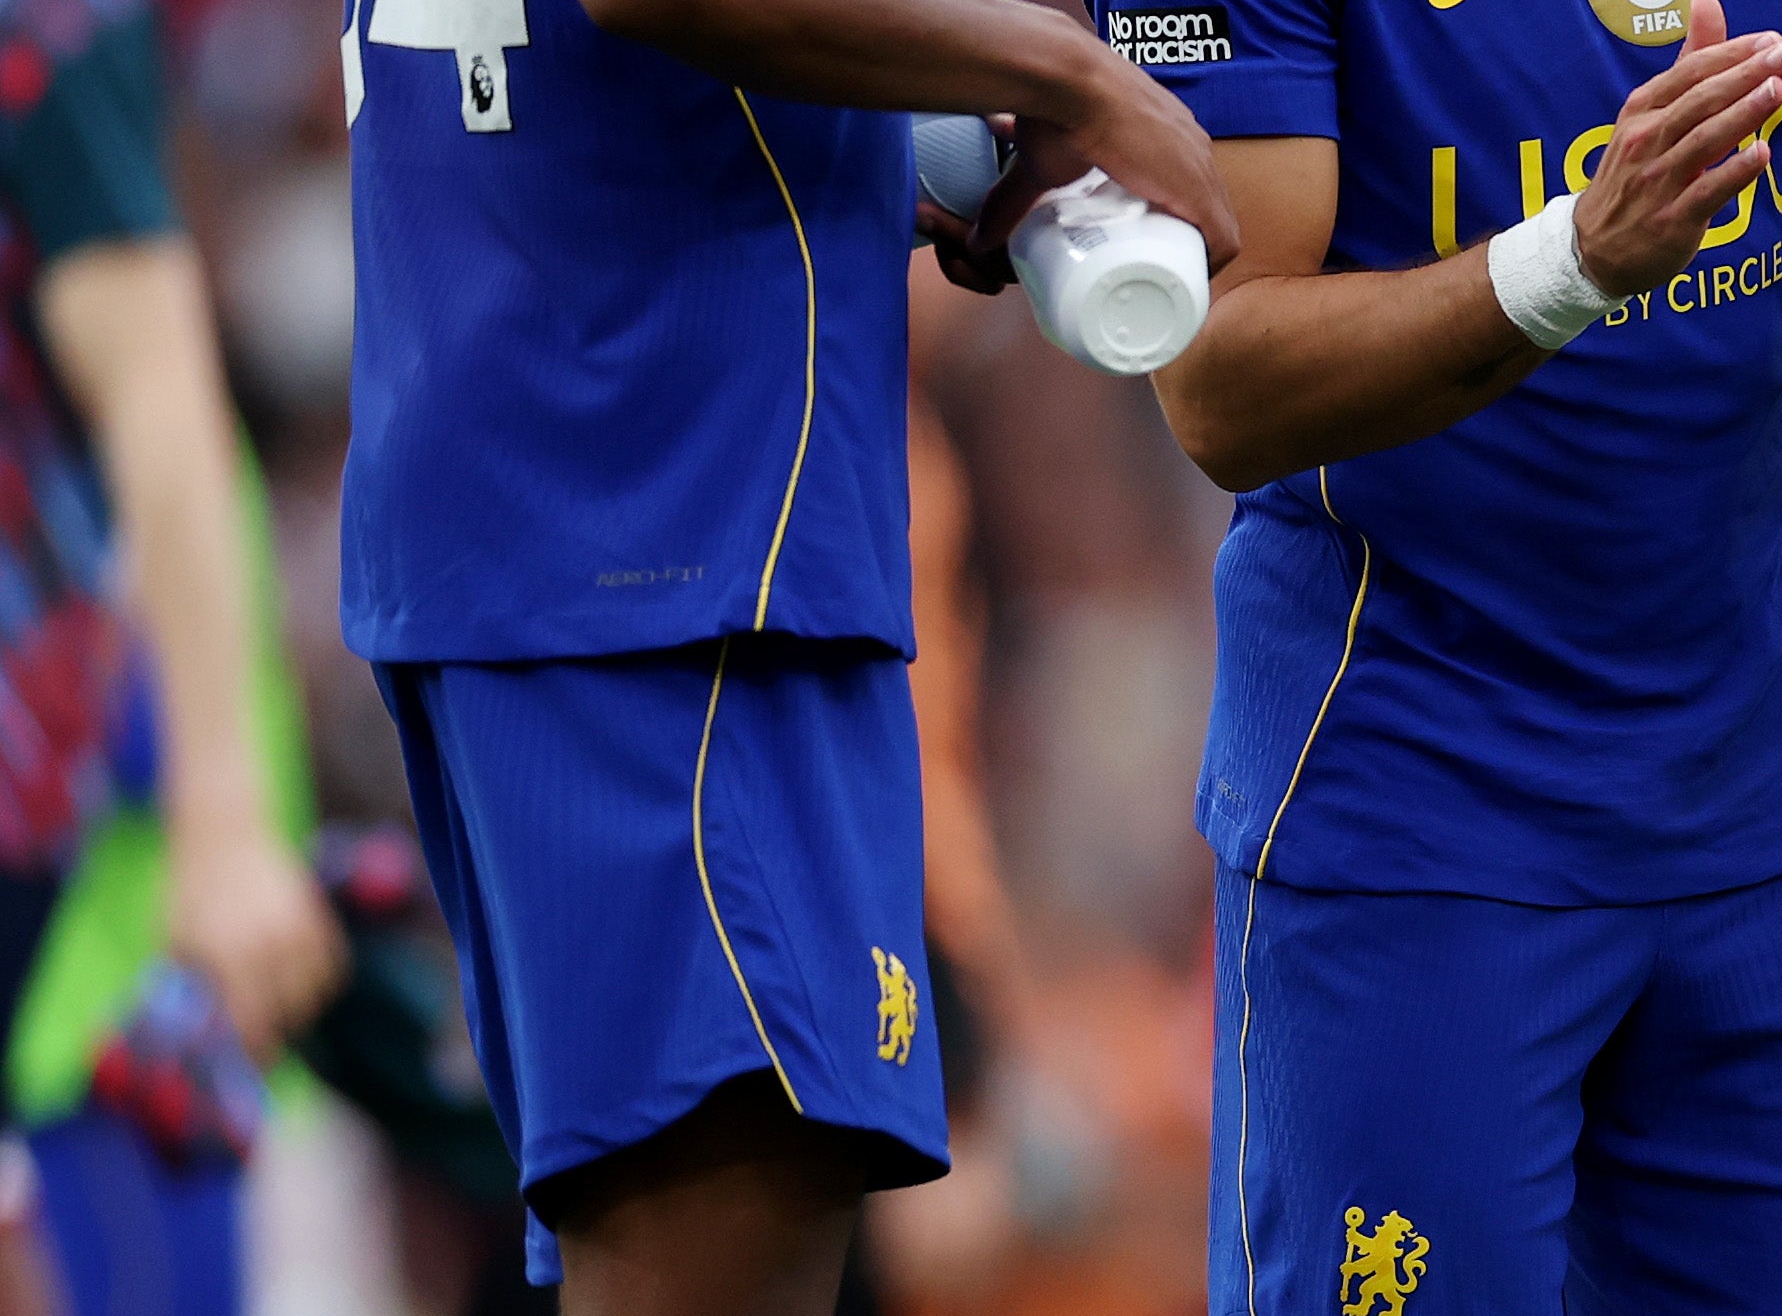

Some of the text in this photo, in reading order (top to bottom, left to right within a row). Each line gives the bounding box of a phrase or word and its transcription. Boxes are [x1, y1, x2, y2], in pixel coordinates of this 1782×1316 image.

[1108, 11, 1214, 40] No room
[1632, 9, 1683, 35] FIFA
[1135, 37, 1232, 65] racism
